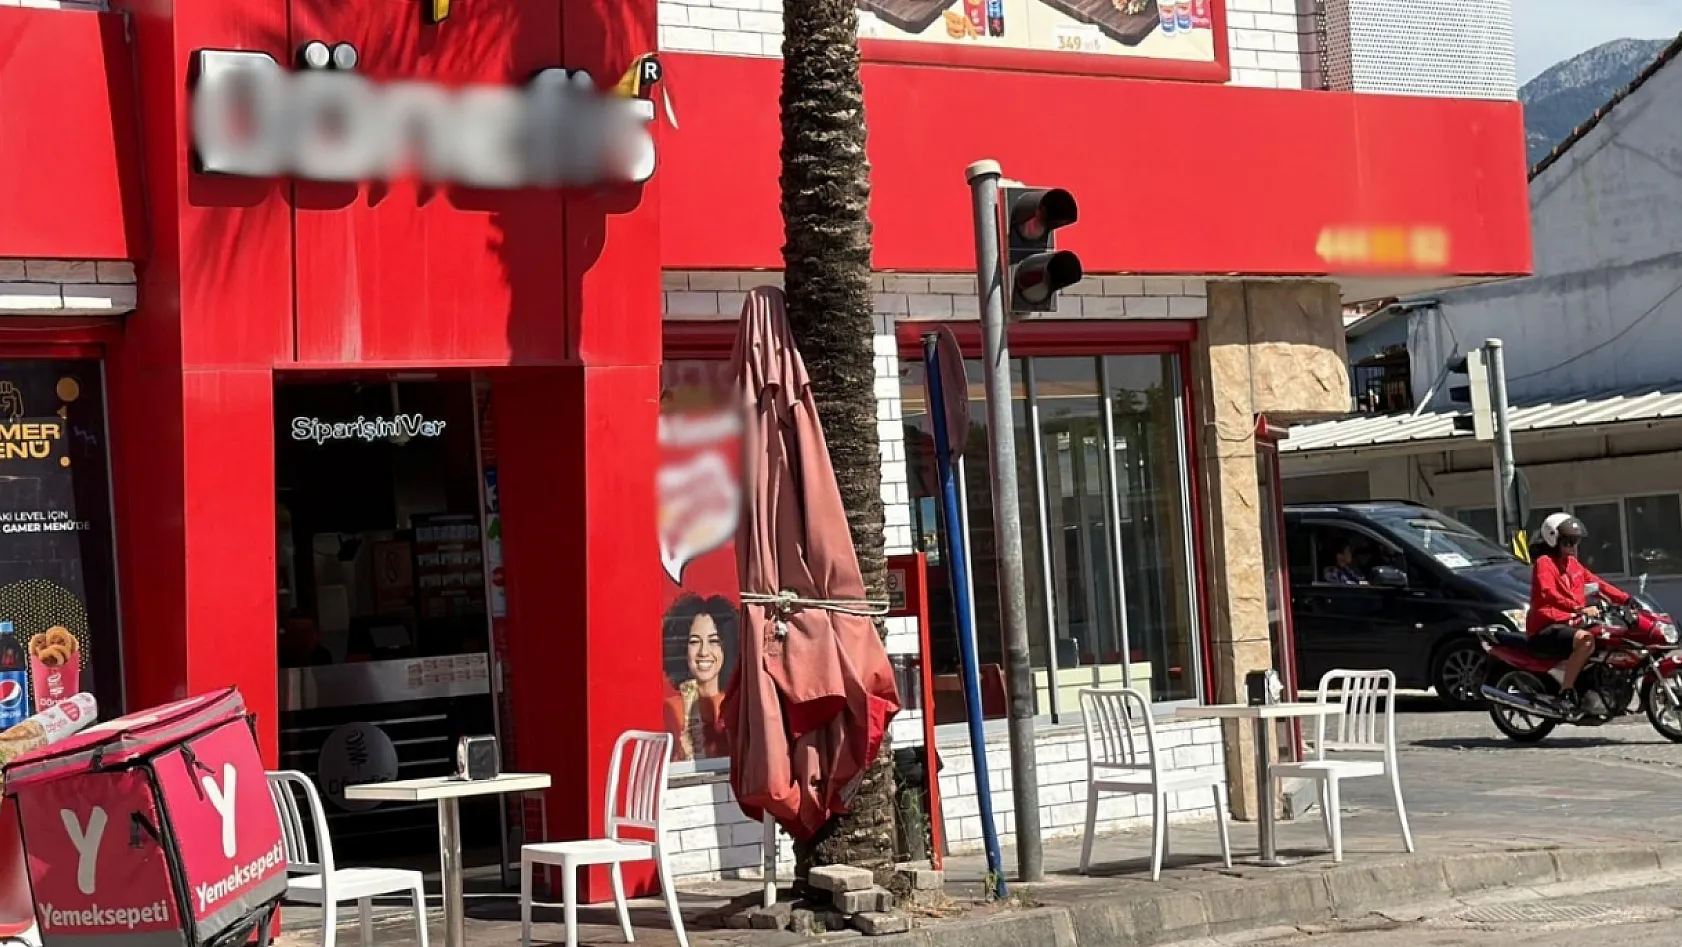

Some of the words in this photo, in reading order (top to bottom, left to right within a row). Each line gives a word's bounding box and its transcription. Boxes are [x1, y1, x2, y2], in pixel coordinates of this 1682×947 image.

[14, 511, 46, 521] LEVEL
[2, 522, 41, 533] GAMER
[196, 839, 285, 912] Yemeksepeti
[39, 900, 170, 929] Yemeksepeti
